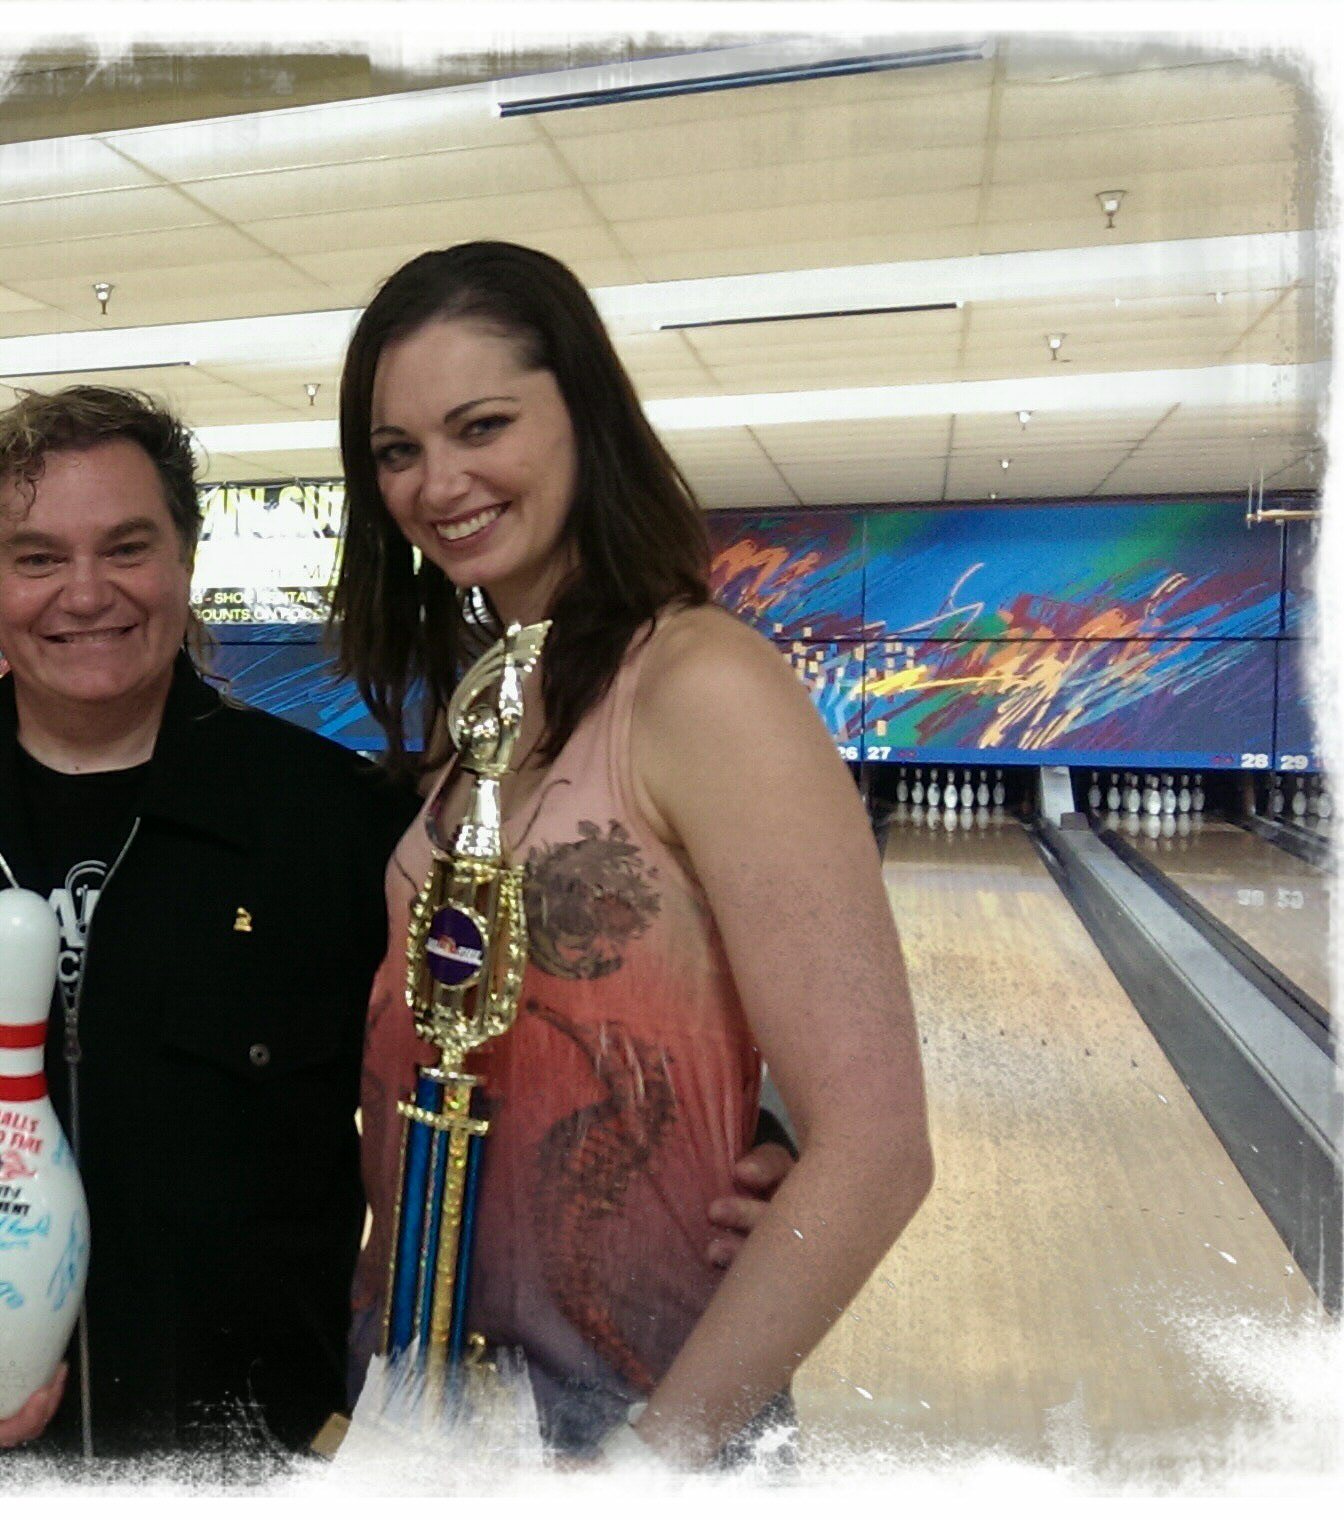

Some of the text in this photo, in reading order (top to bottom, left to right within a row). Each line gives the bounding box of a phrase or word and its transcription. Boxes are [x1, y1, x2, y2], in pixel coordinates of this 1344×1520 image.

[866, 746, 892, 760] 27
[1240, 753, 1269, 769] 28
[1280, 754, 1309, 770] 29
